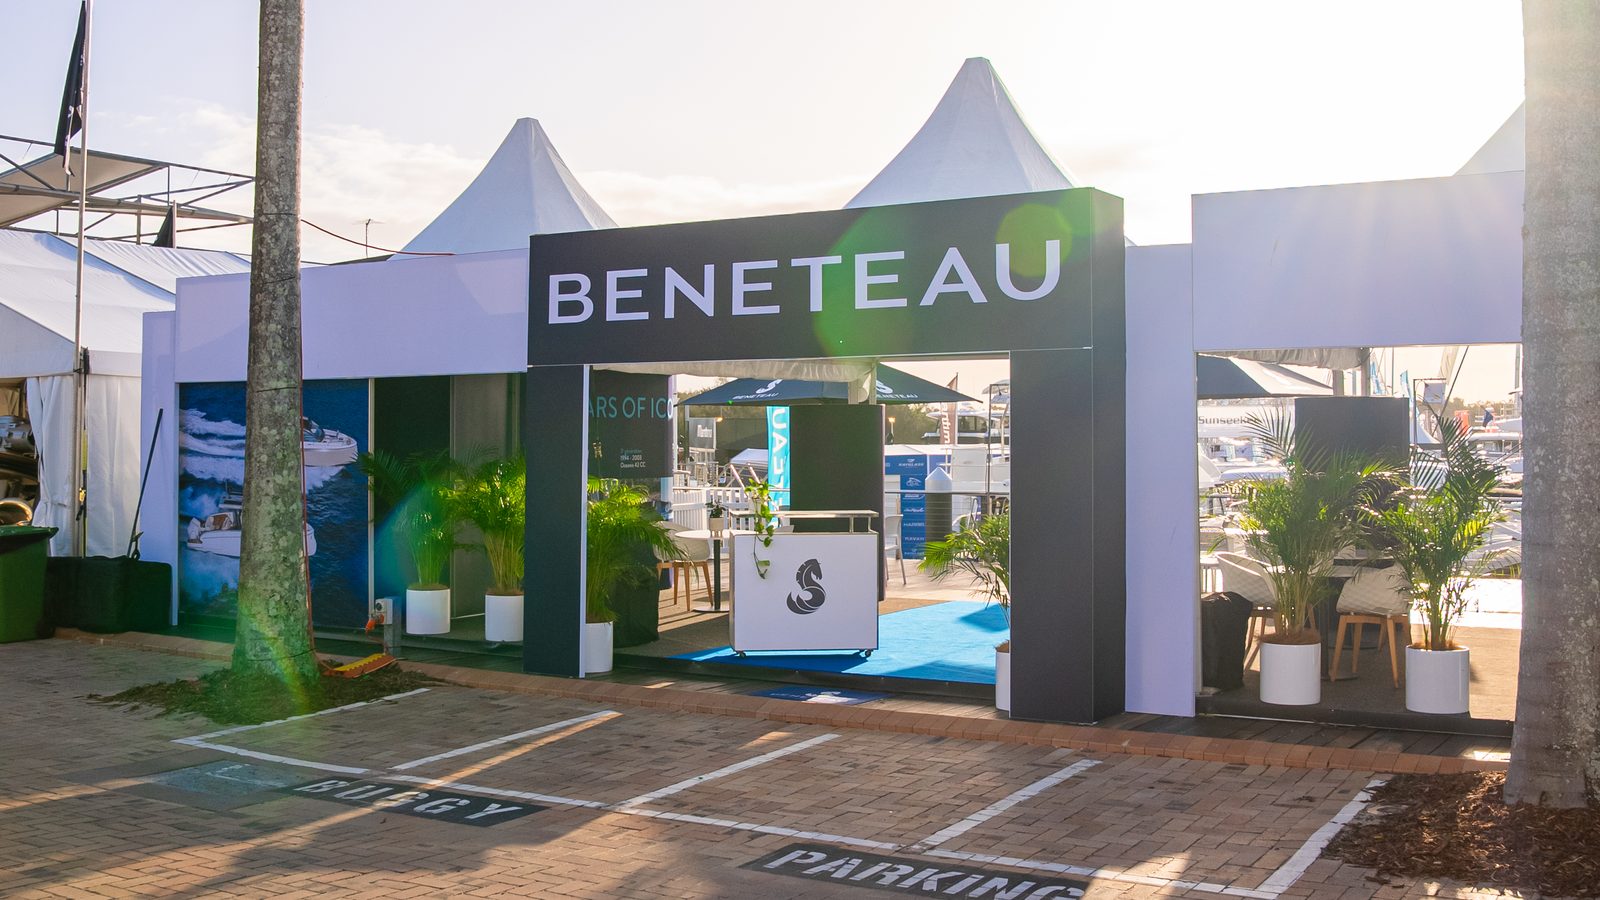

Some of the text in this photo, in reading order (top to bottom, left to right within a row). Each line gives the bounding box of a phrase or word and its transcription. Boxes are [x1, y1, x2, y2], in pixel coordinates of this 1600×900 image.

[547, 239, 1061, 325] BENETEAU
[589, 396, 618, 419] ARS
[622, 396, 647, 419] OF
[732, 392, 779, 400] BENETEAU
[293, 779, 524, 820] BUGGY
[763, 849, 1086, 900] PARKING
